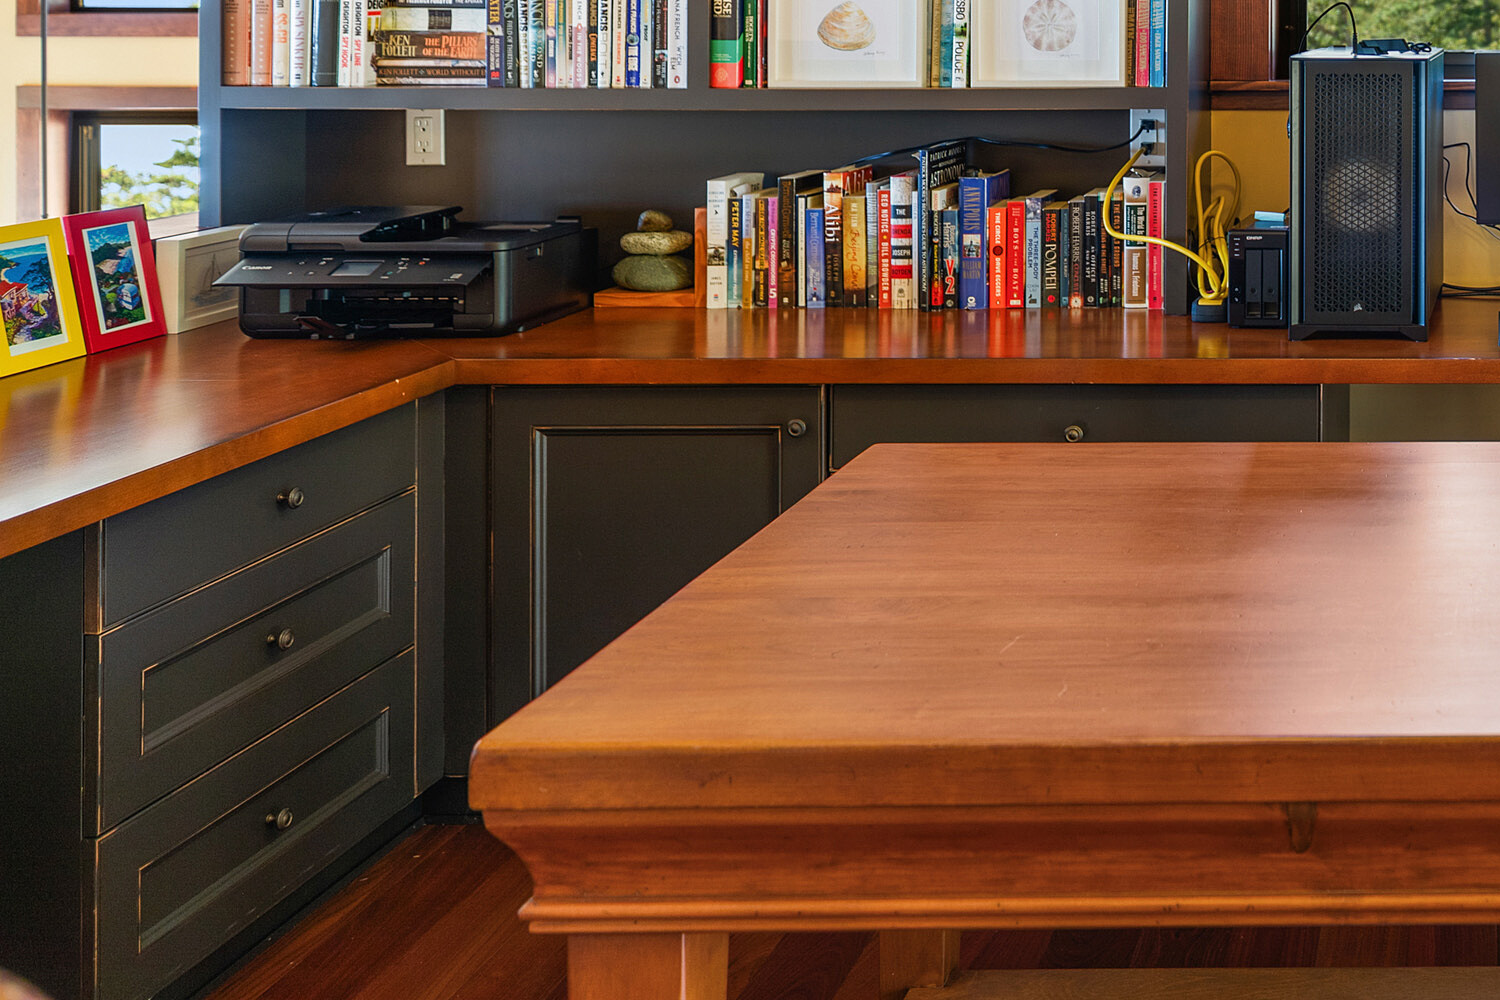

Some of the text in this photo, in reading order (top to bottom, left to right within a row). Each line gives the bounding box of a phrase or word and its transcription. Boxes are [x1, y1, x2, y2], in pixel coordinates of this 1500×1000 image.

[382, 35, 417, 56] KEN FOLLETT
[824, 203, 840, 242] Alibi
[964, 186, 980, 230] ANNAPOLIS
[1045, 244, 1056, 289] POMPEII
